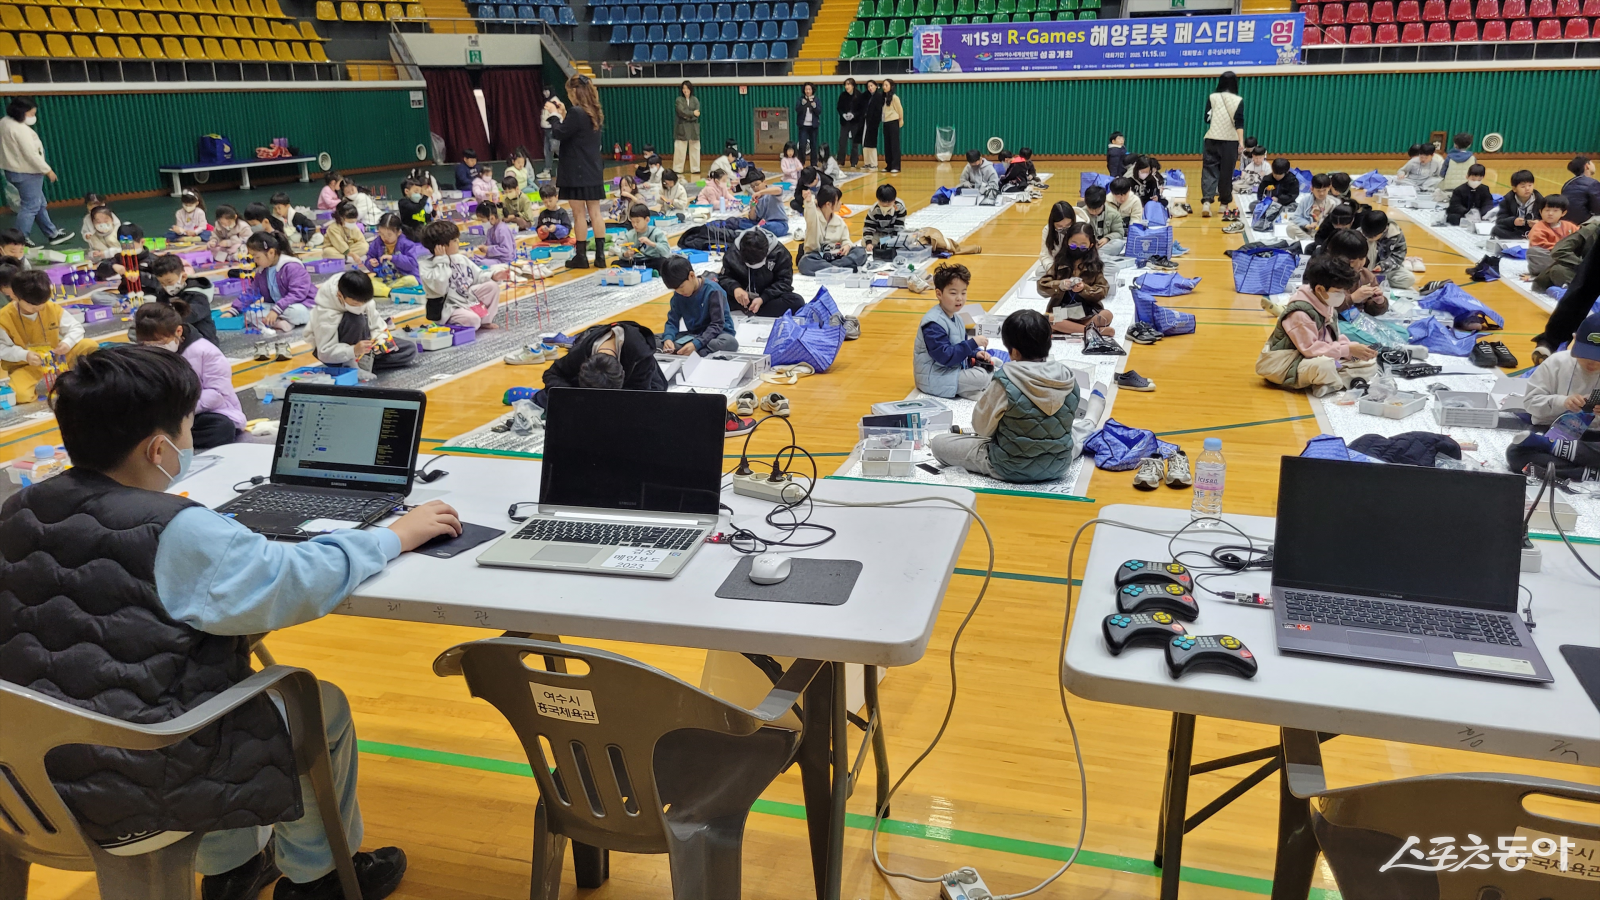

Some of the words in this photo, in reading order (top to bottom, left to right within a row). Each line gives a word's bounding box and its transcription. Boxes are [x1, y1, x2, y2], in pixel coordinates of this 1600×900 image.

[961, 31, 1002, 46] 제15회
[1007, 28, 1086, 45] R-Games
[1090, 23, 1168, 47] 해양로봇
[1173, 19, 1256, 45] 페스티벌
[1271, 20, 1295, 46] 영
[921, 32, 941, 55] 환
[1039, 50, 1074, 60] 성공개최
[613, 554, 660, 564] 메인보드
[614, 562, 645, 570] 2023
[543, 691, 581, 707] 여수시
